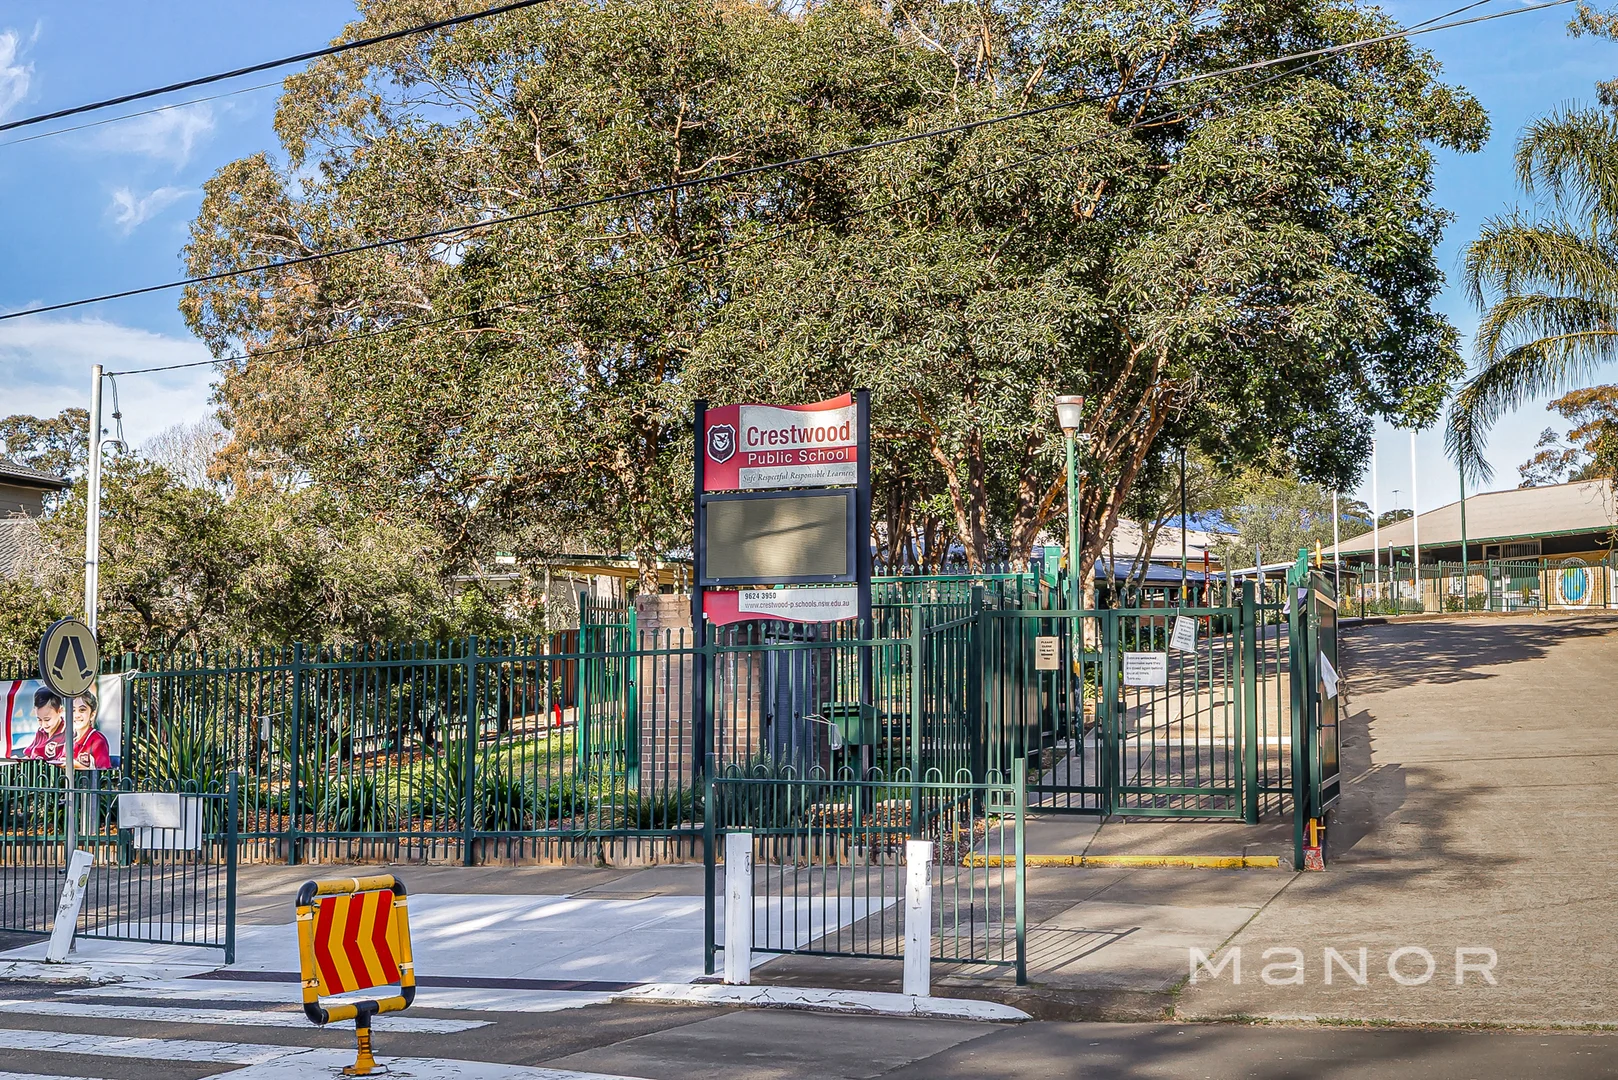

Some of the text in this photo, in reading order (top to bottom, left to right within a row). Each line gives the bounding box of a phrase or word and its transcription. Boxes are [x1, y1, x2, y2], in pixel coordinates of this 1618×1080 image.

[747, 421, 850, 446] Crestwood
[748, 448, 849, 465] Public School
[743, 469, 856, 483] Safe Respectful Responsible Learners
[744, 600, 850, 609] www.crestwood-p.schools.nsw.edu.au
